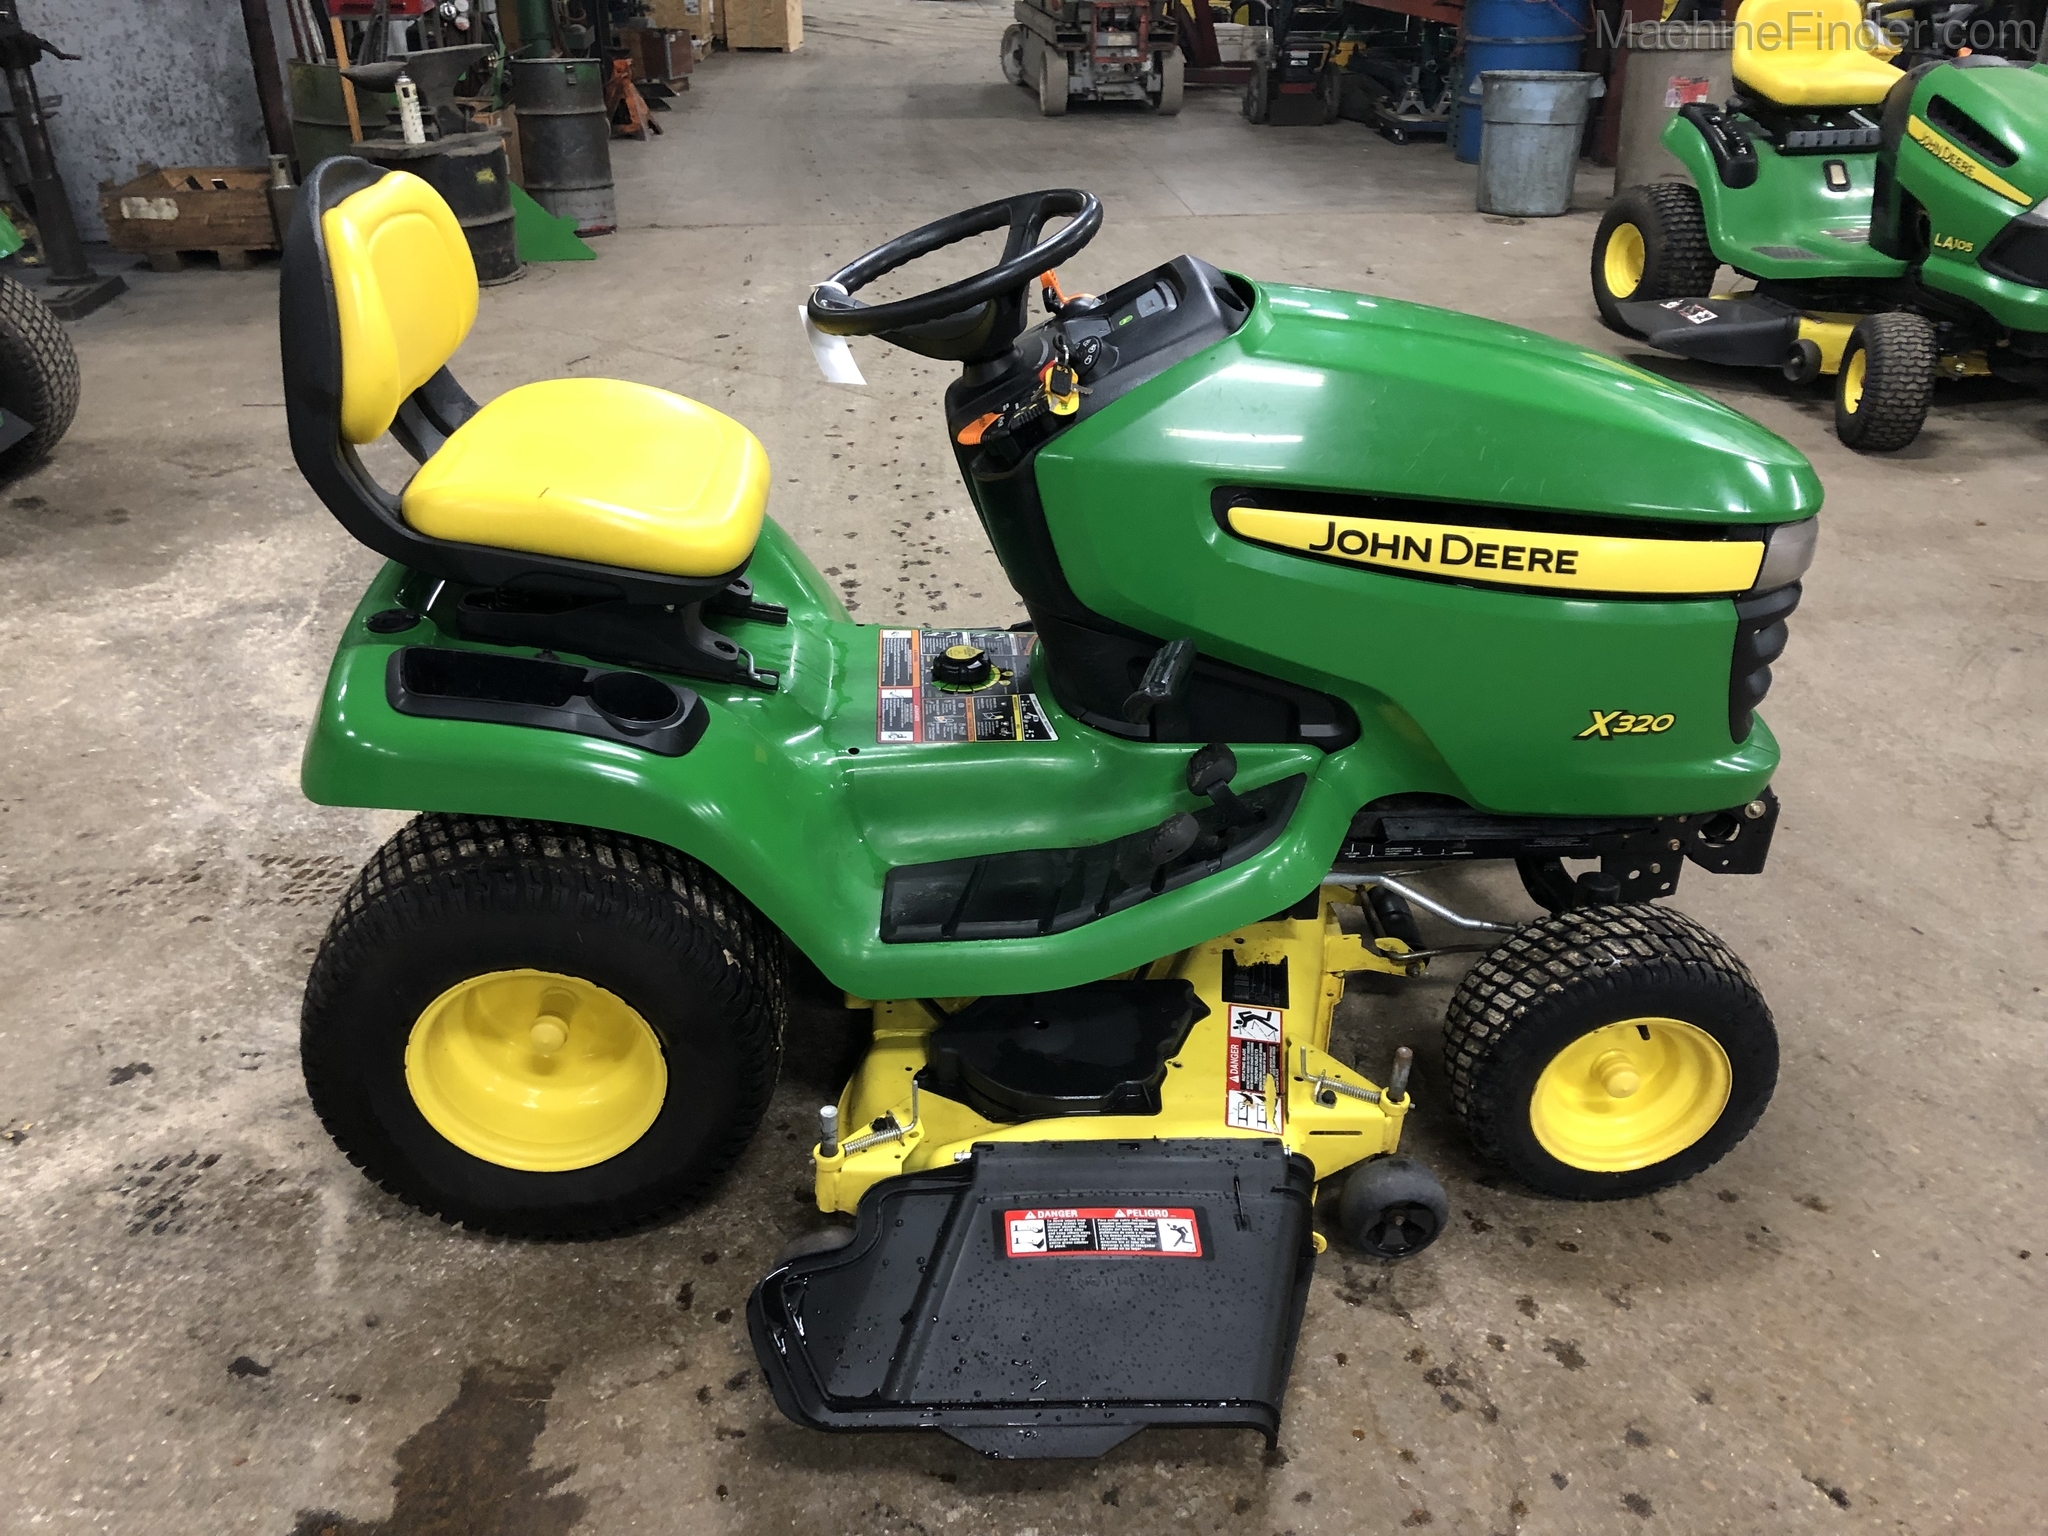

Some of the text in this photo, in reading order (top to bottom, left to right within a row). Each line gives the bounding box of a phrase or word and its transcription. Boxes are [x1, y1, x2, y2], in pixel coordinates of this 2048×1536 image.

[1941, 146, 1976, 177] DEERE
[1933, 232, 1975, 252] LA105
[1309, 521, 1579, 575] JOHN DEERE
[1572, 710, 1676, 740] X320
[1229, 1044, 1240, 1075] DANGER
[1037, 1209, 1078, 1218] DANGER
[1126, 1209, 1169, 1218] PELIGRO
